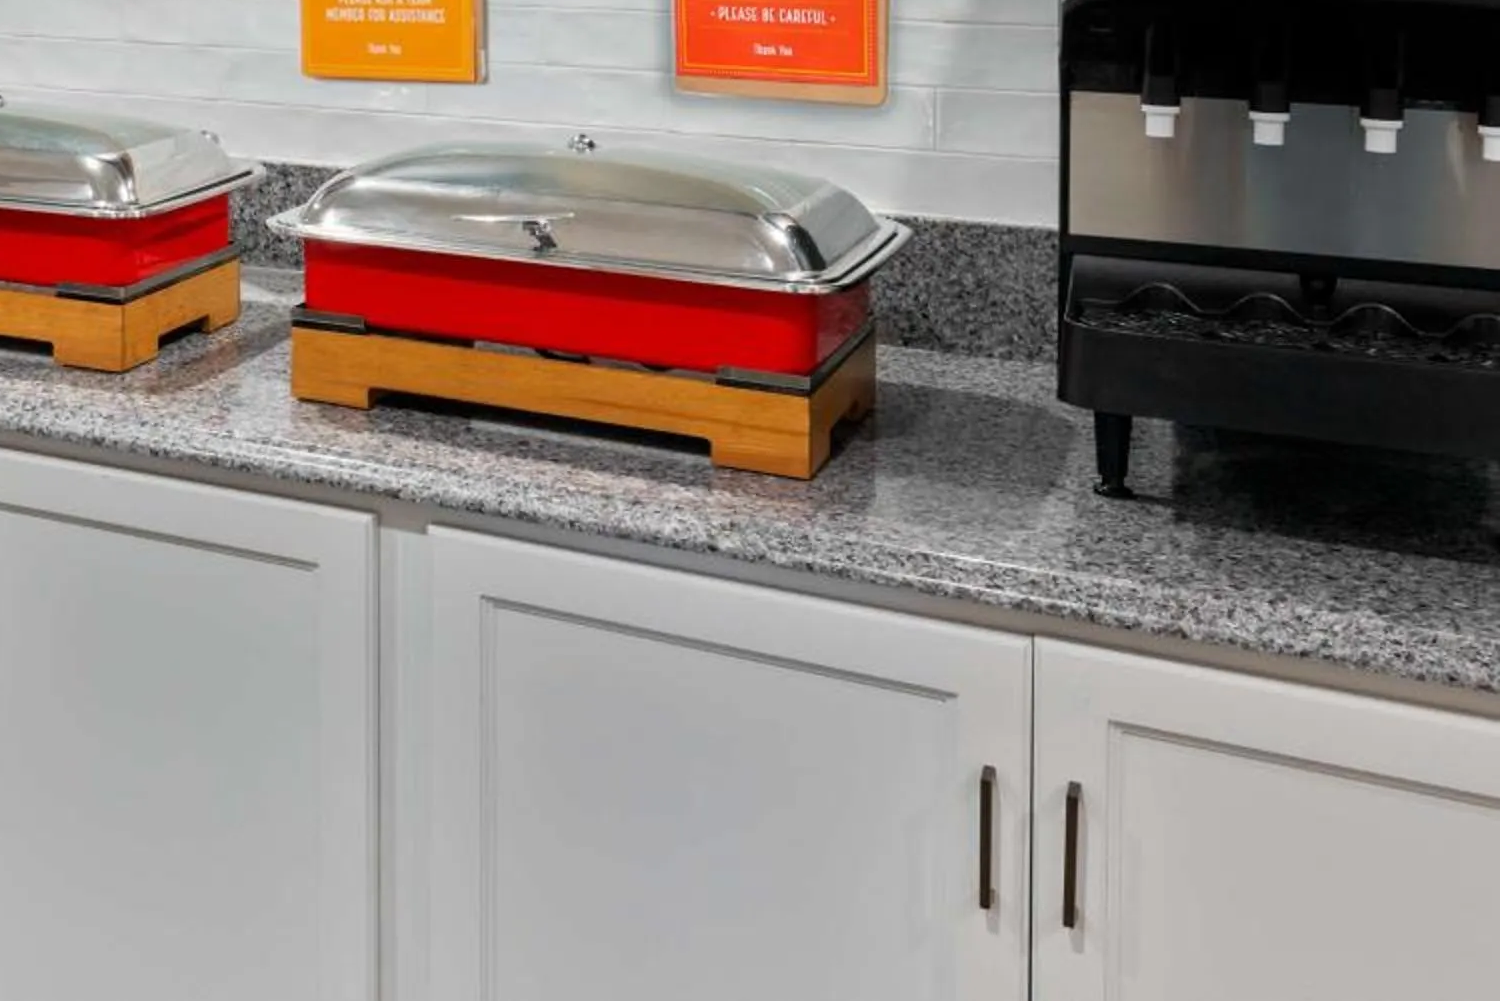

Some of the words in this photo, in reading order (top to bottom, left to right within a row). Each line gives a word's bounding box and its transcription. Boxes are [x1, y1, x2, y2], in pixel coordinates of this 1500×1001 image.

[325, 7, 365, 22] MEMBER
[718, 6, 757, 22] PLEASE
[761, 7, 776, 22] BE
[779, 8, 827, 25] CAREFUL
